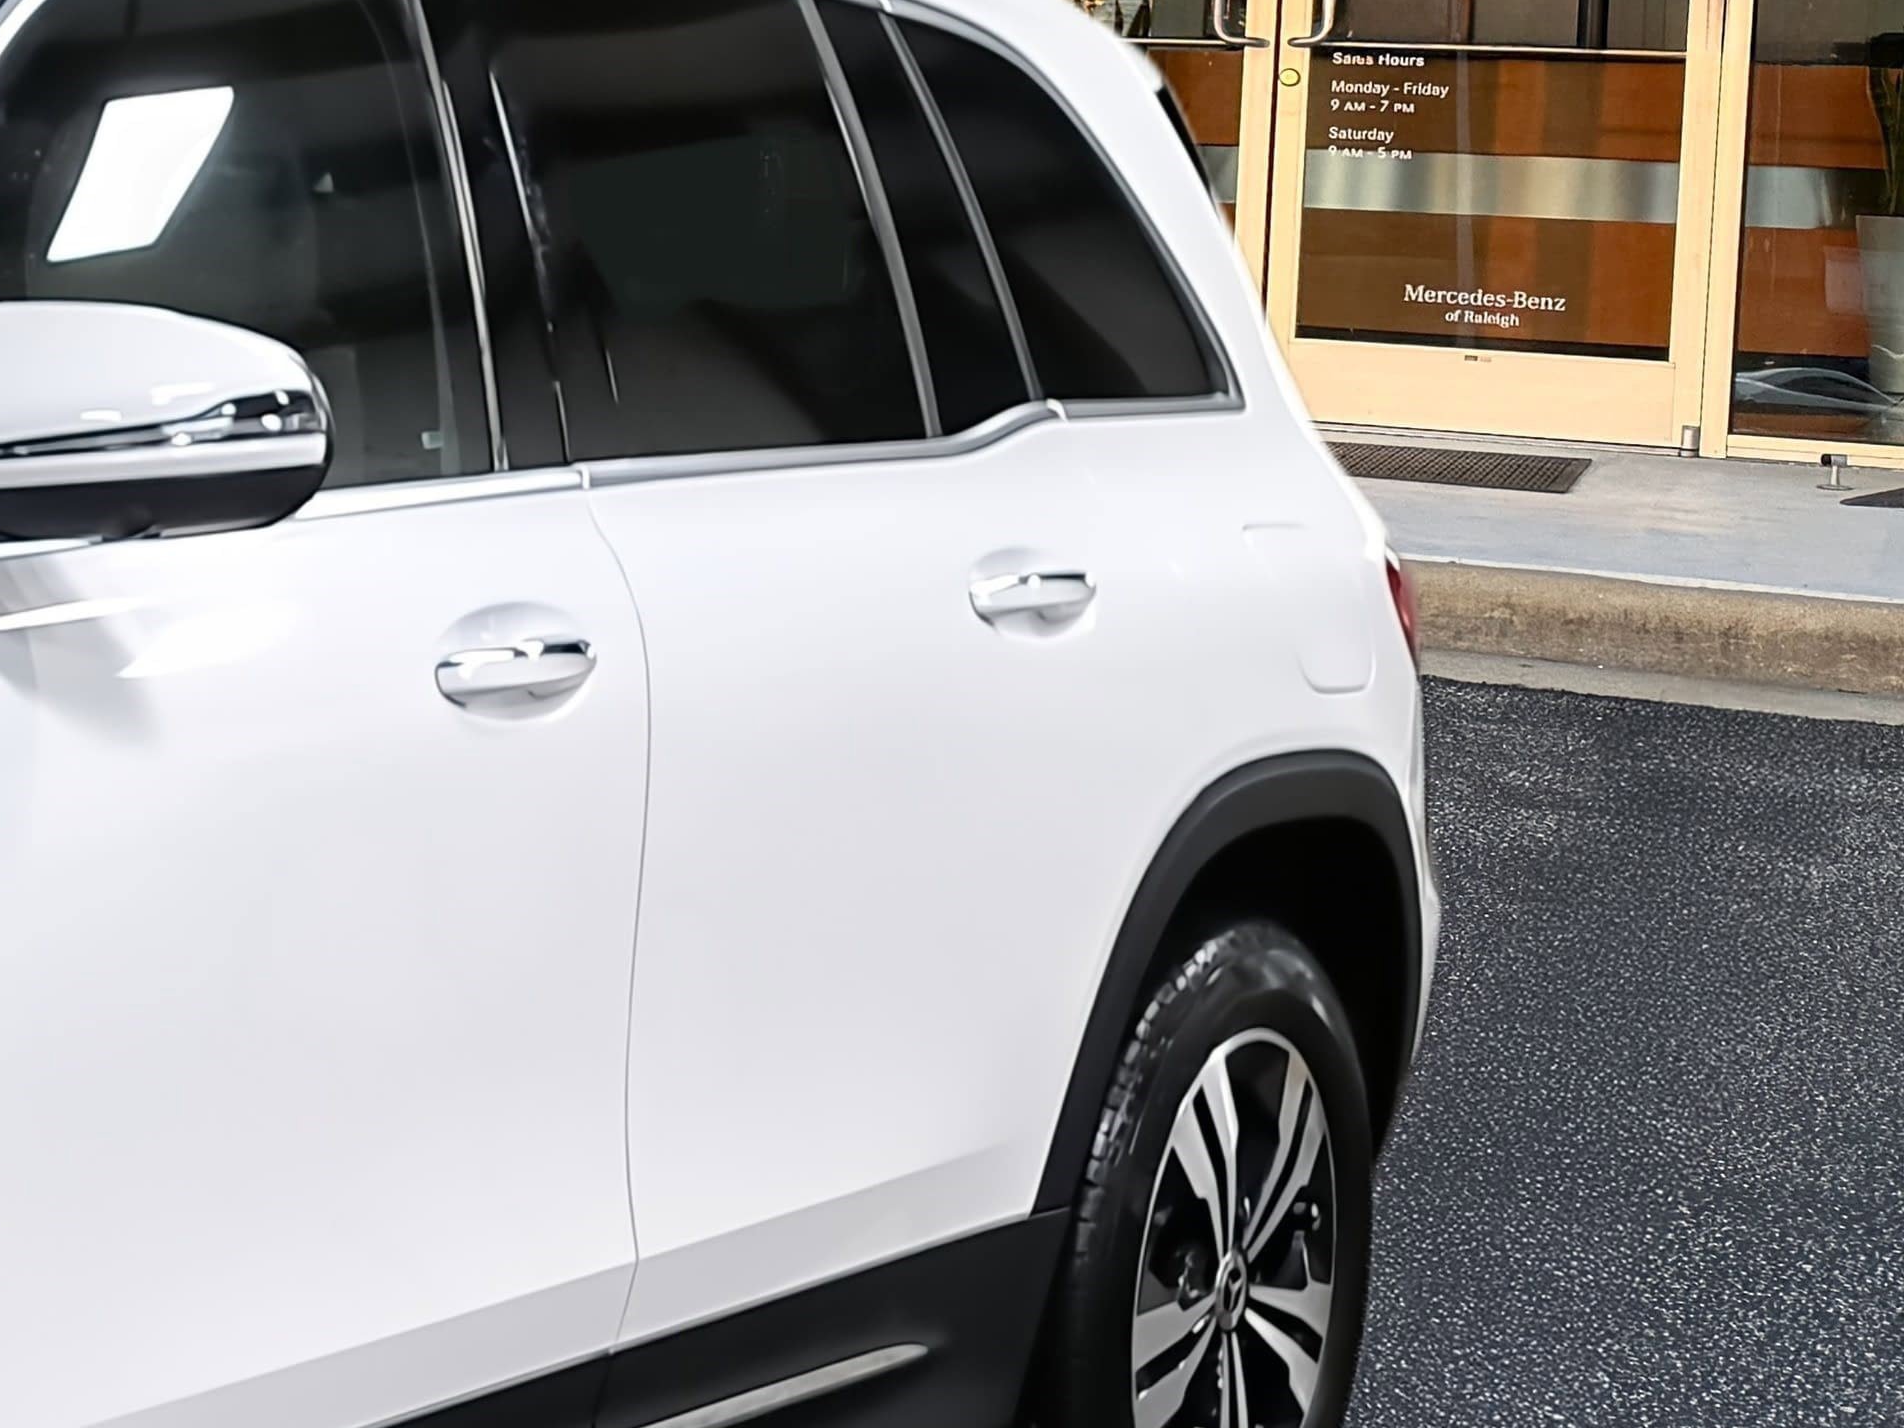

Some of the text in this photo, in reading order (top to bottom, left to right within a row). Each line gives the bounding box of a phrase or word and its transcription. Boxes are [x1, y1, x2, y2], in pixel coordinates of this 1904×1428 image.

[1378, 53, 1425, 67] Hours
[1331, 80, 1390, 98] Monday
[1403, 82, 1450, 99] Friday
[1330, 98, 1340, 111] 9
[1343, 101, 1366, 112] AM
[1379, 99, 1390, 113] 7
[1393, 103, 1415, 113] PM
[1328, 126, 1394, 144] Saturday
[1377, 146, 1387, 159] 5
[1391, 149, 1413, 160] PM
[1403, 283, 1567, 312] Mercedes-Benz
[1445, 309, 1520, 329] of Raleigh
